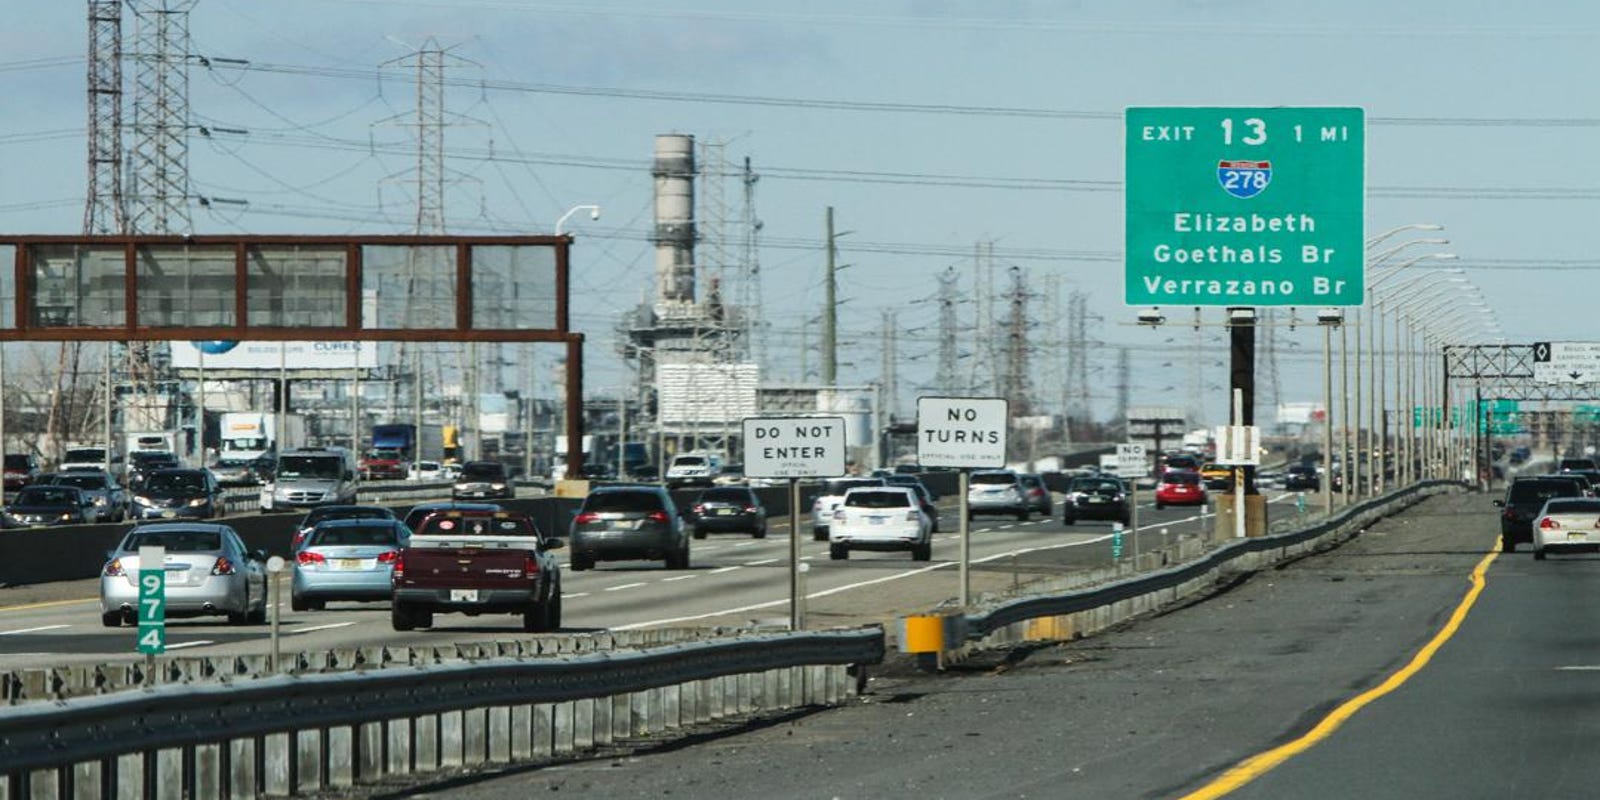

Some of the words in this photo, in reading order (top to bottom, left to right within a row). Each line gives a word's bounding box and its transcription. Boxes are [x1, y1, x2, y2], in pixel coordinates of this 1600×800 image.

[1142, 126, 1196, 141] EXIT
[1220, 118, 1267, 146] 13
[1294, 125, 1302, 142] 1
[1321, 126, 1348, 141] MI
[1225, 171, 1266, 189] 278
[1174, 213, 1315, 232] Elizabeth
[1154, 245, 1283, 263] Goethals
[1302, 246, 1335, 263] Br
[1143, 276, 1294, 295] Verrazano
[1313, 277, 1346, 295] Br
[947, 408, 977, 421] NO
[755, 427, 780, 439] DO
[796, 425, 833, 438] NOT
[925, 429, 999, 444] TURNS
[763, 447, 825, 459] ENTER
[1123, 446, 1141, 454] NO
